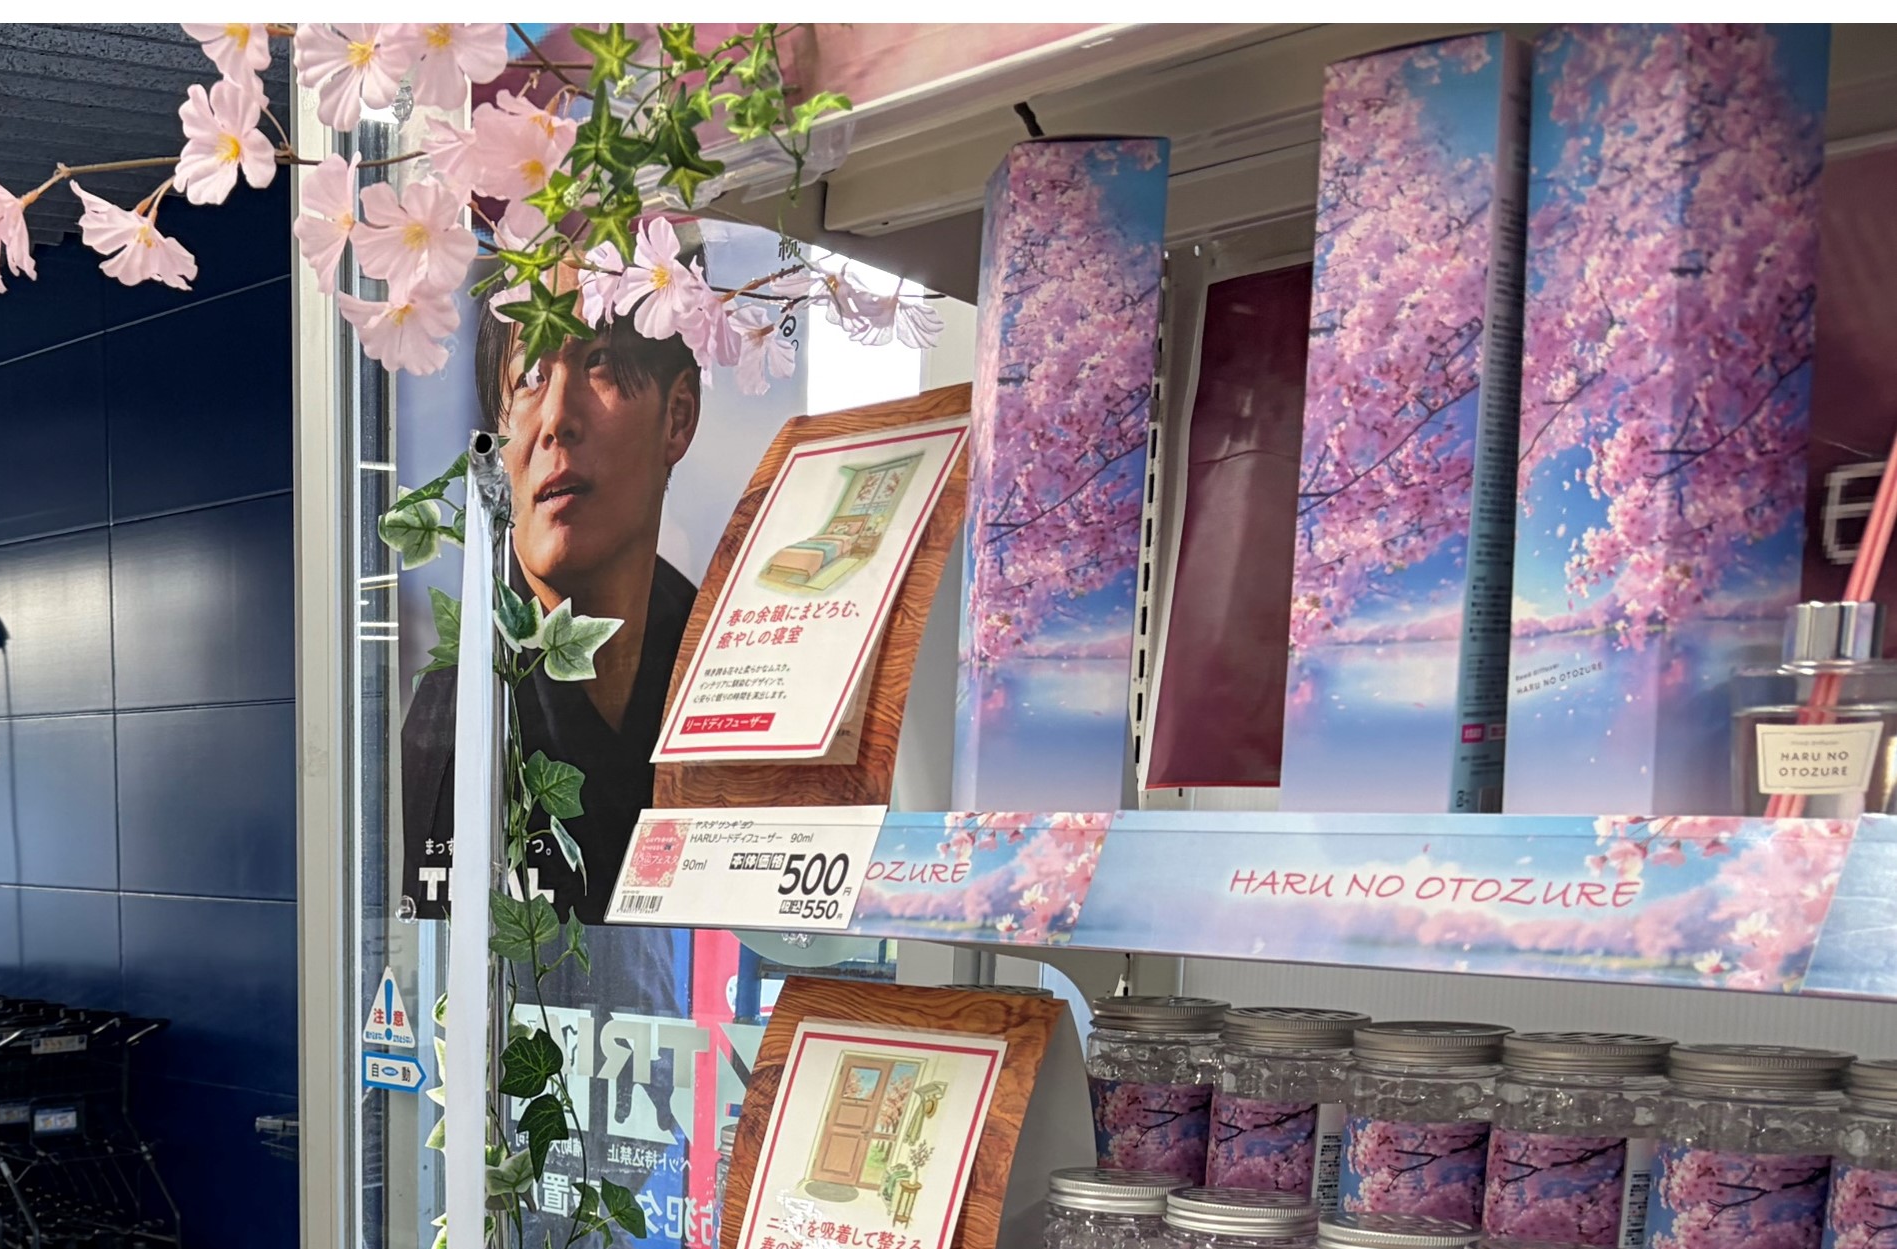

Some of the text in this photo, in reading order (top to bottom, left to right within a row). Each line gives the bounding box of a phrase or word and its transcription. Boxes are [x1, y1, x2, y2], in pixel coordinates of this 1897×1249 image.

[726, 600, 862, 627] 春の余韻にまどろむ、
[716, 625, 804, 650] 癒やしの寝室
[686, 715, 770, 731] リードディフューザー
[1781, 751, 1849, 762] HARU NO
[1779, 766, 1848, 777] OTOZURE
[790, 833, 814, 843] 90ml
[681, 859, 707, 871] 90ml
[729, 853, 850, 897] 本体価格 500
[1229, 867, 1642, 910] HARU NO OTOZURE
[801, 899, 839, 920] 550
